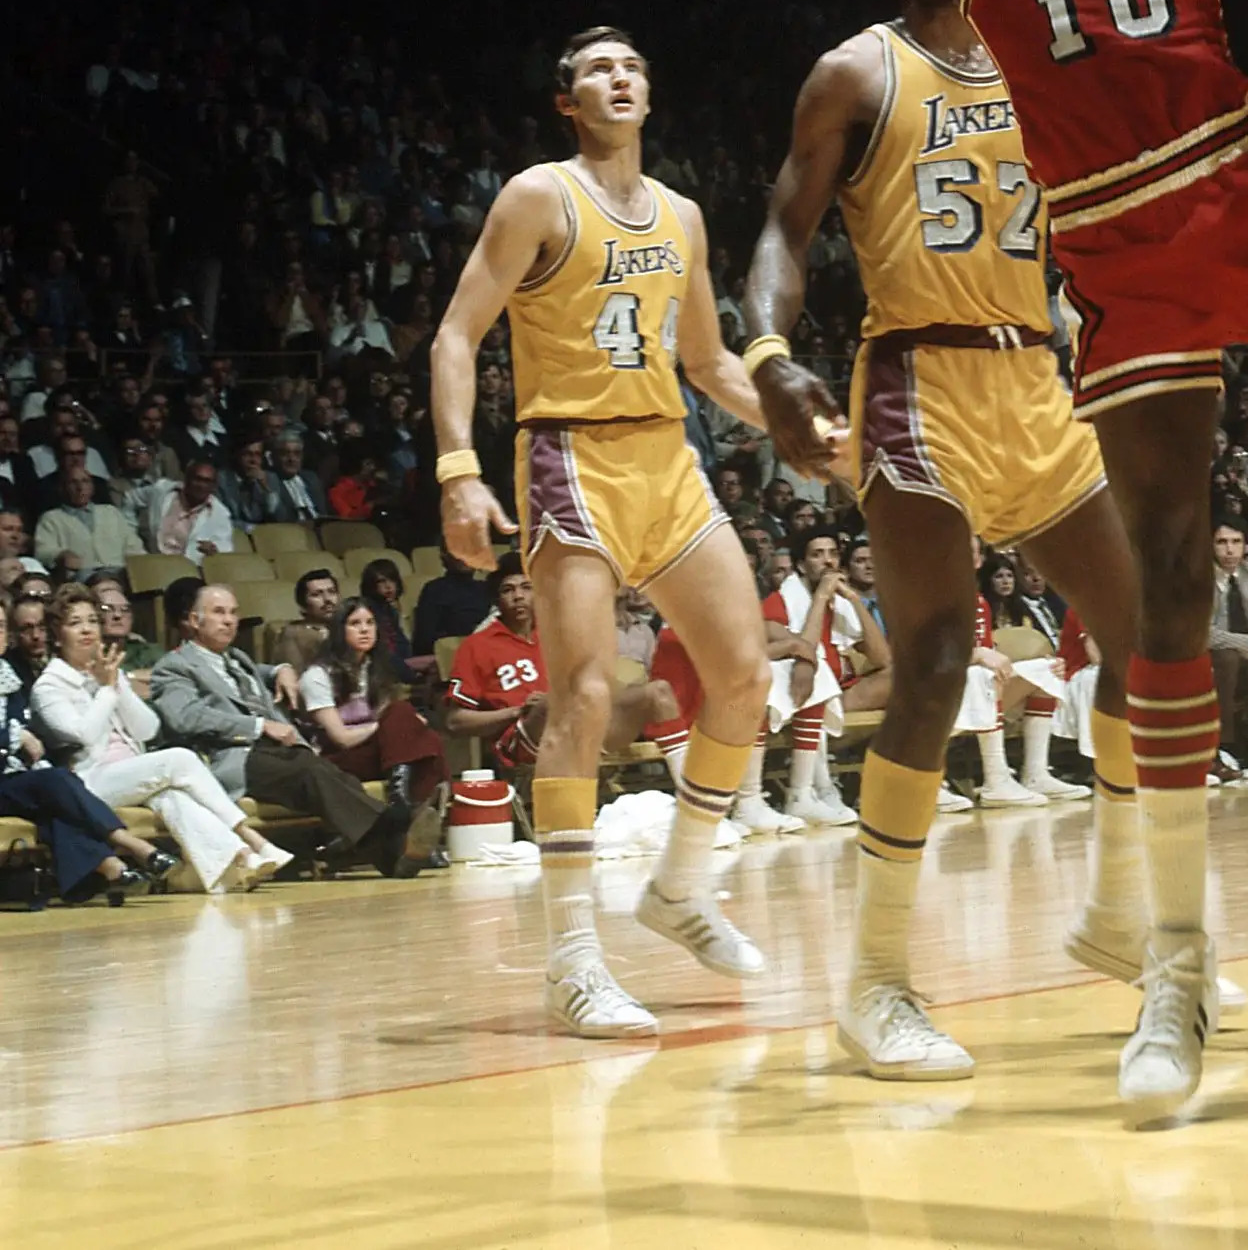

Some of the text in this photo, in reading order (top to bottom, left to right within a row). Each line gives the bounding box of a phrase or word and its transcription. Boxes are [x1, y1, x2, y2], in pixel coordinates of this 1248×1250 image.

[919, 91, 1016, 157] LAKER
[913, 158, 1042, 262] 52
[594, 239, 683, 287] LAKERS
[496, 658, 540, 692] 23
